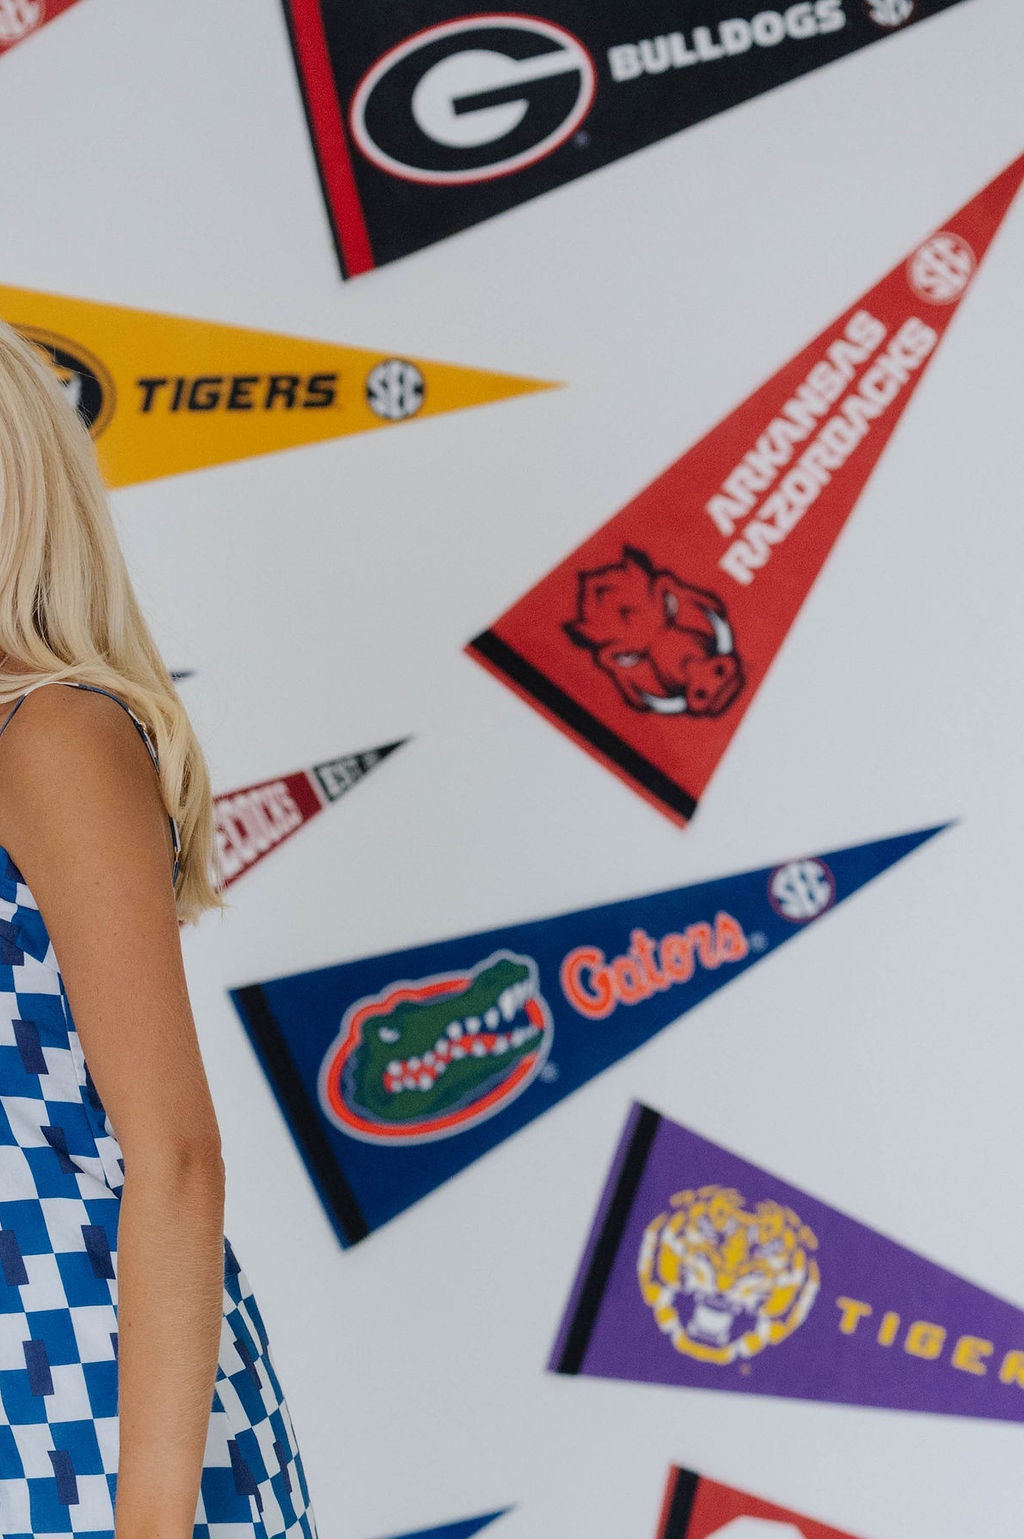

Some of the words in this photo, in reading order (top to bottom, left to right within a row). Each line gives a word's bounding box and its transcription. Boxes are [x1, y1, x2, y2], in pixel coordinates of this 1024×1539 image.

[607, 0, 847, 83] BULLDOGS
[137, 374, 338, 413] TIGERS
[705, 309, 887, 537] ARKANSAS
[719, 316, 937, 586] RAZORBACKS
[560, 910, 749, 1021] Gators
